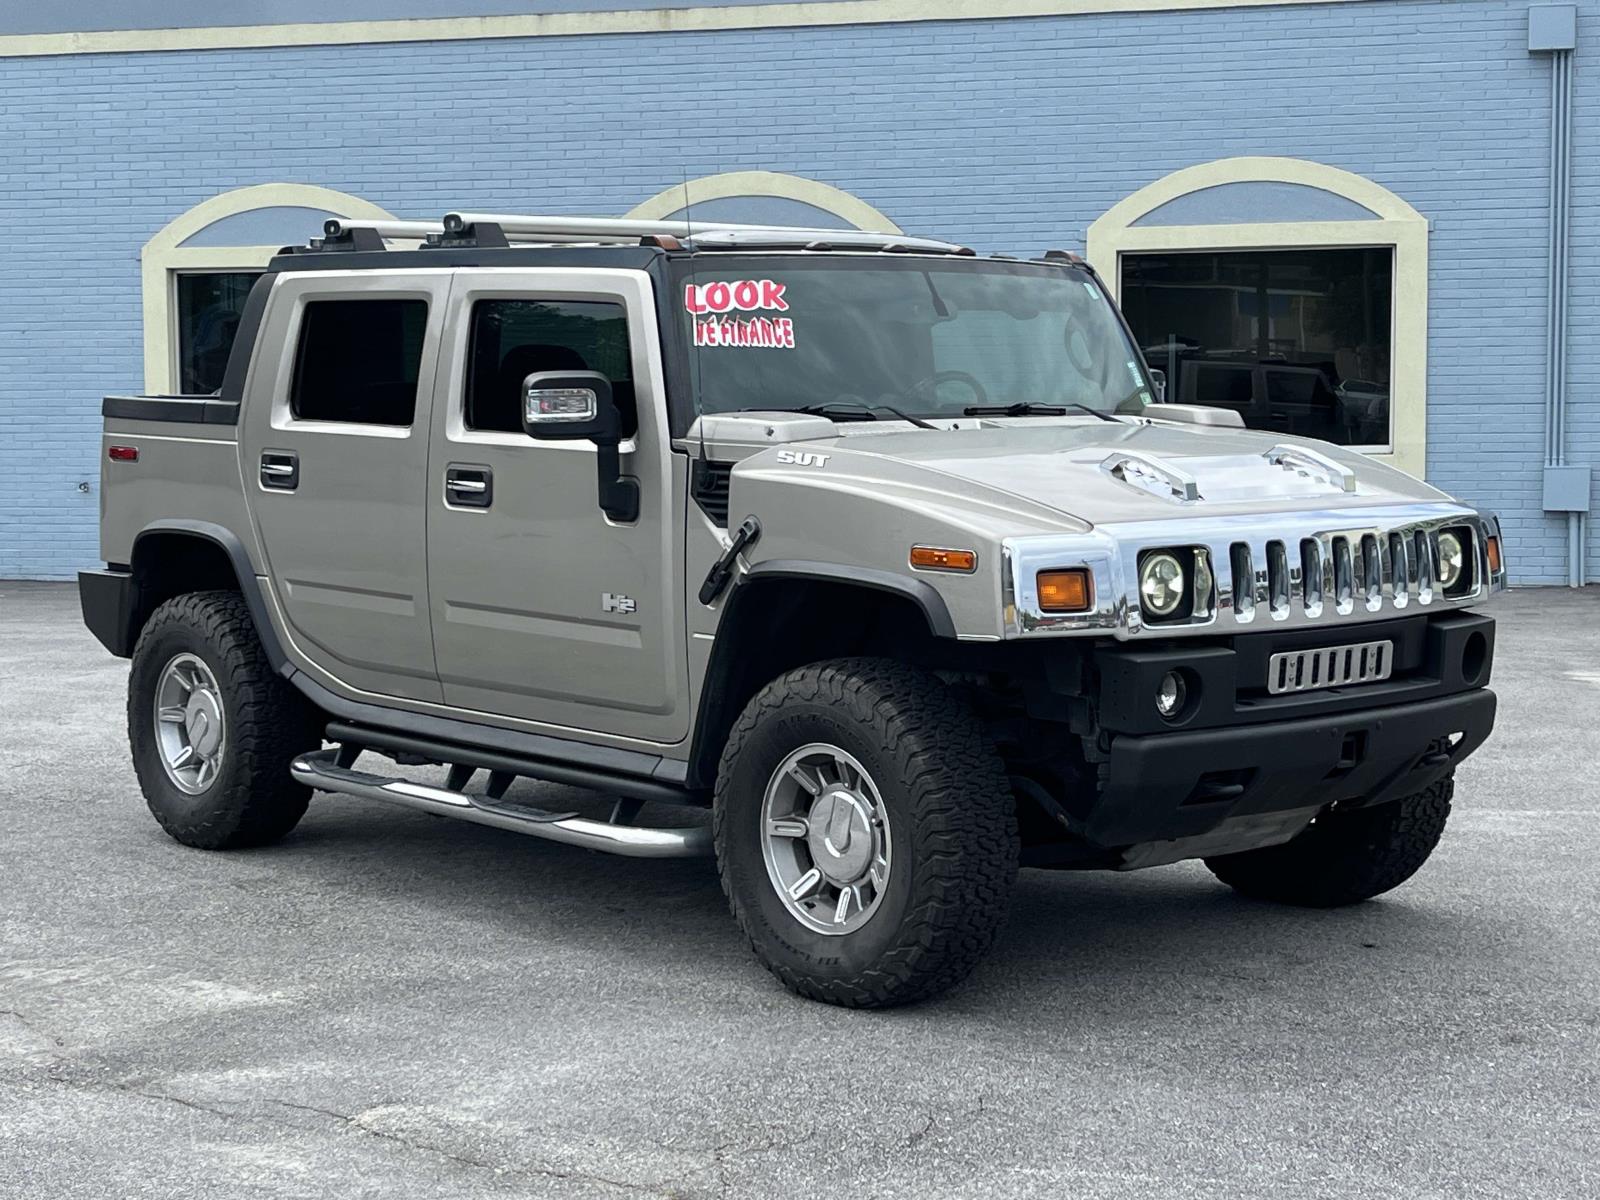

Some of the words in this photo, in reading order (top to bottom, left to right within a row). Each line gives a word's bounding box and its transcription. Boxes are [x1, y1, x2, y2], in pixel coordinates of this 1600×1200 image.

[685, 279, 789, 314] LOOK
[719, 314, 795, 348] FINANCE
[777, 450, 831, 468] SUT
[602, 593, 636, 614] H2
